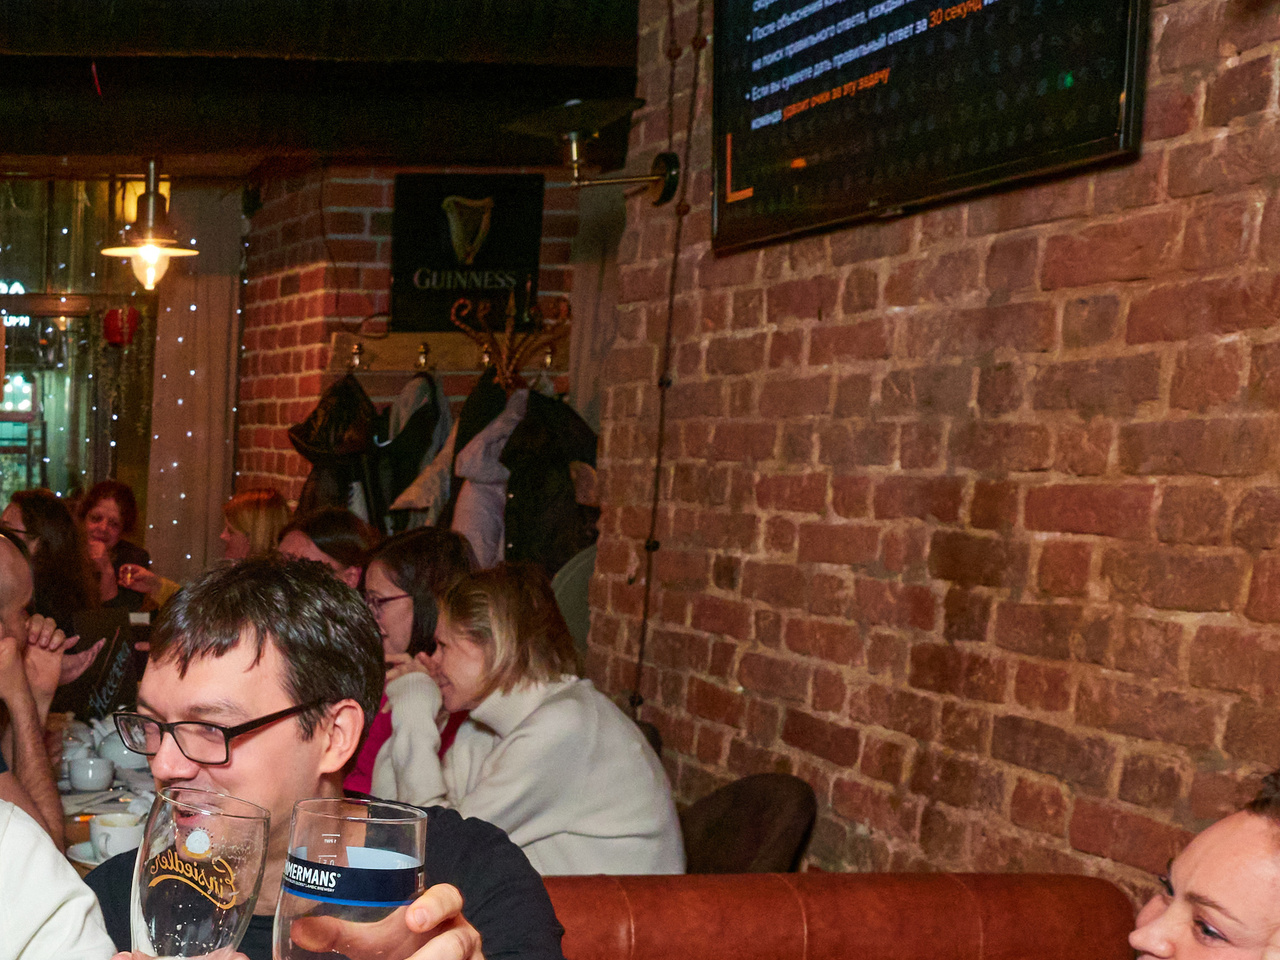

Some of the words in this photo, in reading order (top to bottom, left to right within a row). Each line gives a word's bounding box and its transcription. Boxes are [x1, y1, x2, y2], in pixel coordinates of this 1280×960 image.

[887, 23, 914, 45] ответ
[914, 18, 928, 34] за
[928, 8, 943, 28] 30
[413, 268, 517, 290] GUINNESS
